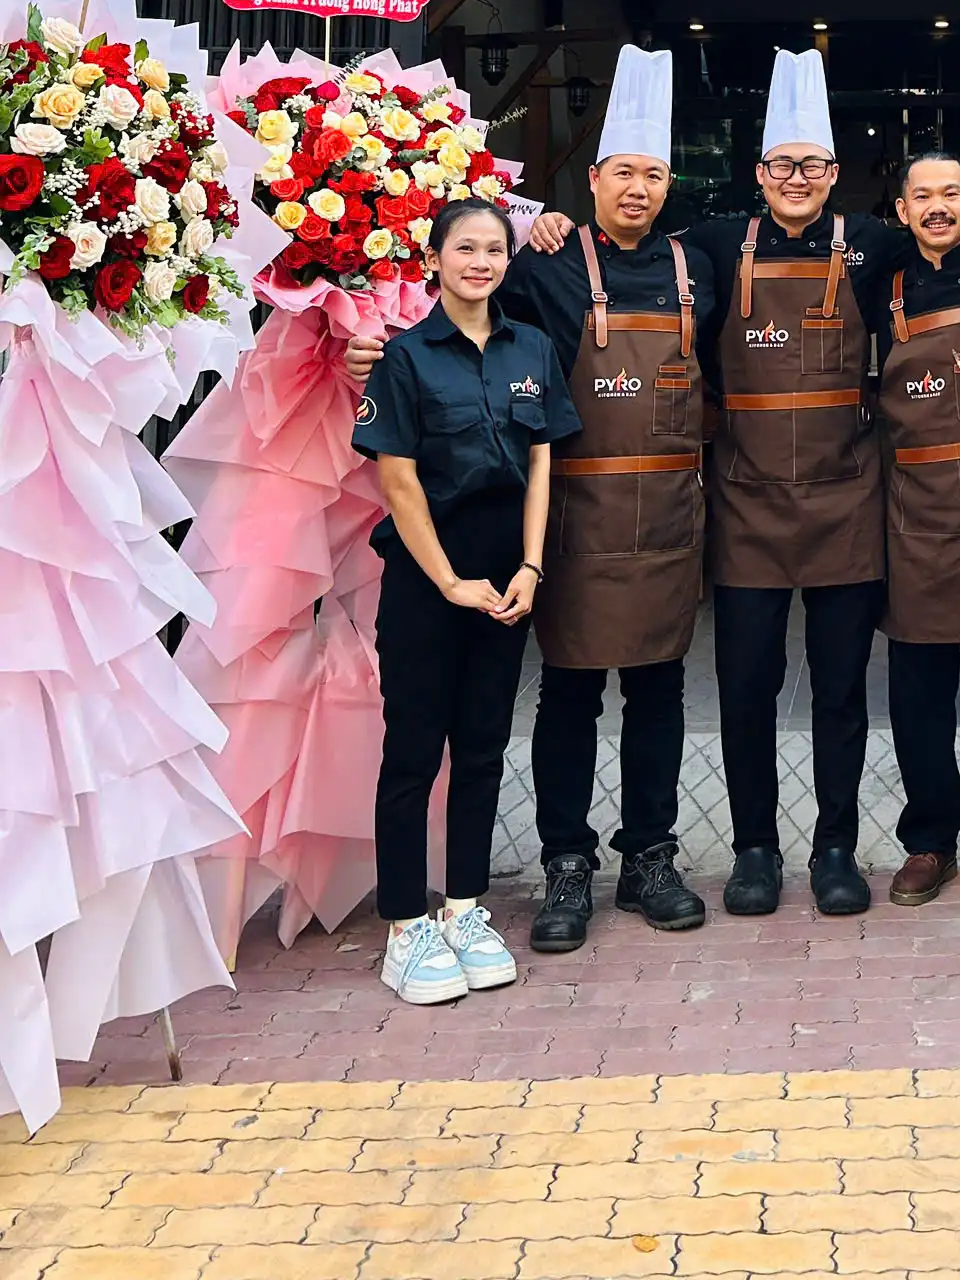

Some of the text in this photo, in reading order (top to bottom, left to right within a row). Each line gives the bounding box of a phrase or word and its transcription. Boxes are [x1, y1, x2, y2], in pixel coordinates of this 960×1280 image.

[745, 320, 789, 342] PYRO
[509, 375, 540, 395] PYRO
[594, 367, 642, 391] PYRO
[906, 369, 946, 394] PYRO
